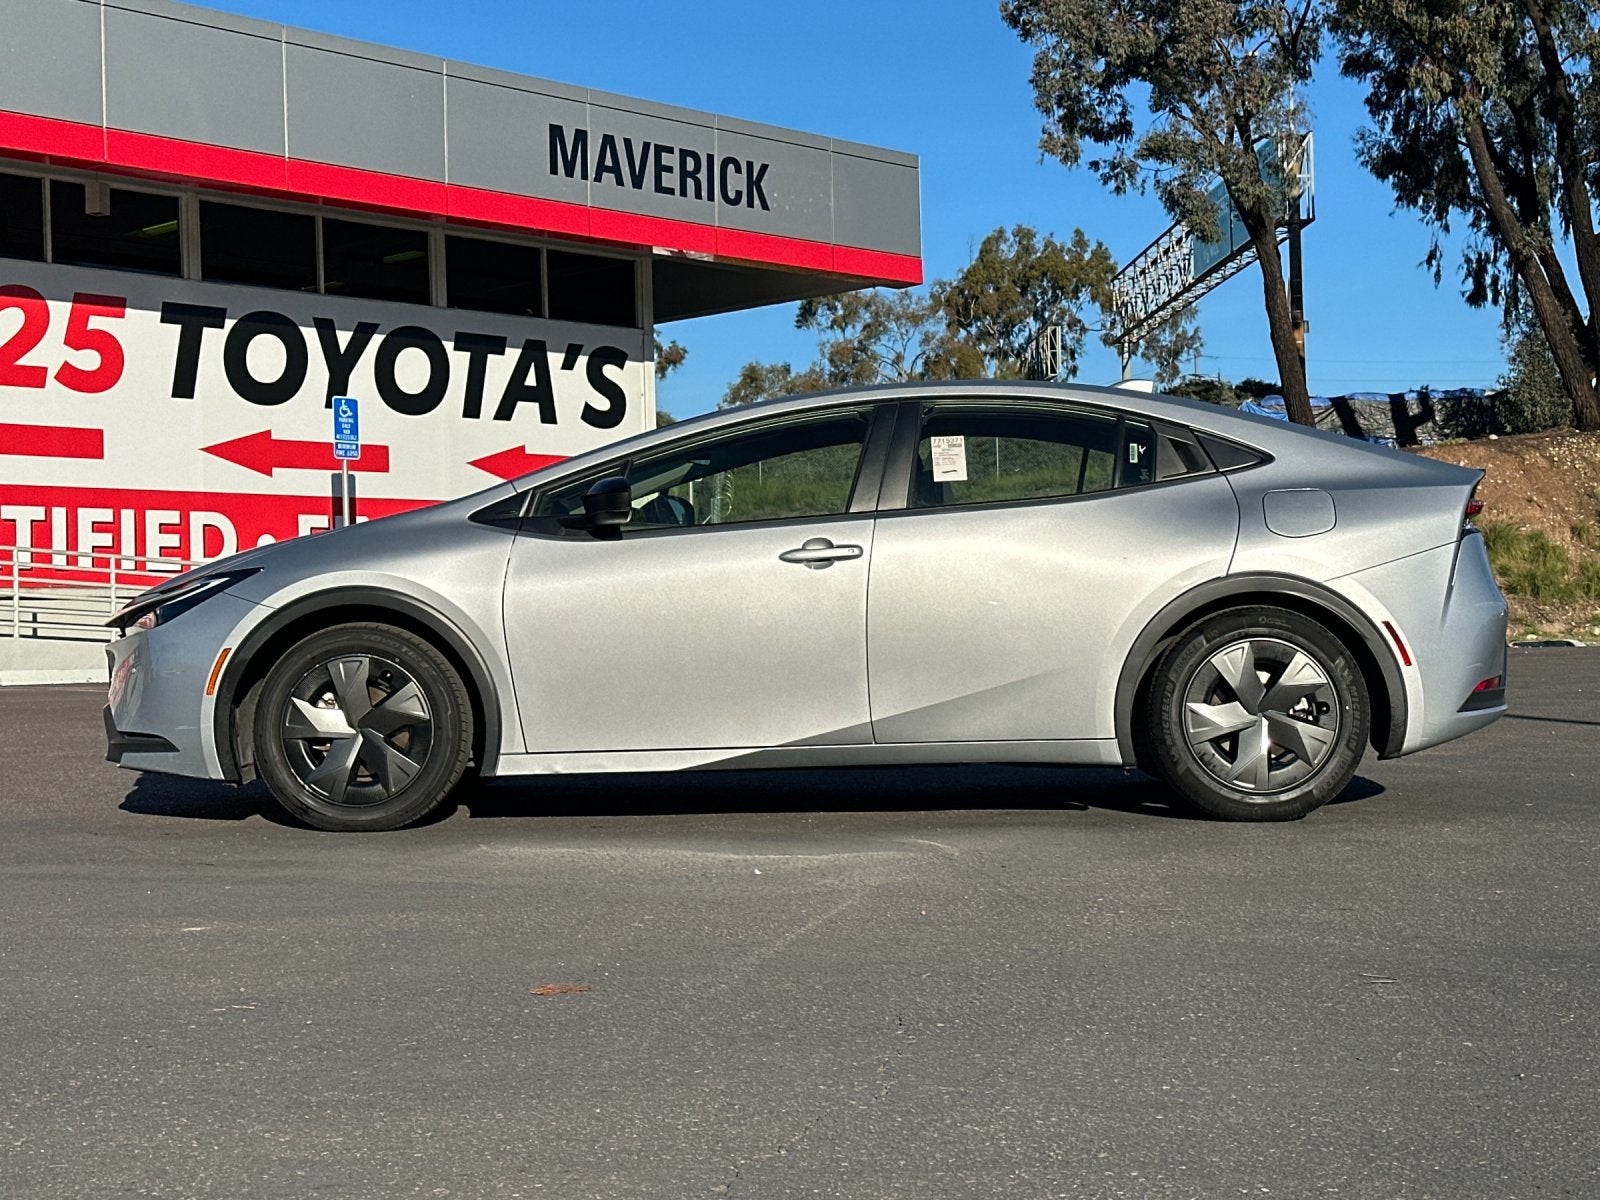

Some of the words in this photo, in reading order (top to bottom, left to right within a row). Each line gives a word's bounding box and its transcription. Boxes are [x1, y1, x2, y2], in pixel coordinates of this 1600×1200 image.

[549, 123, 770, 211] MAVERICK
[0, 284, 127, 394] 25
[160, 301, 629, 430] TOYOTA'S
[1160, 680, 1175, 747] MICHELIN
[1350, 686, 1361, 749] MICHELIN
